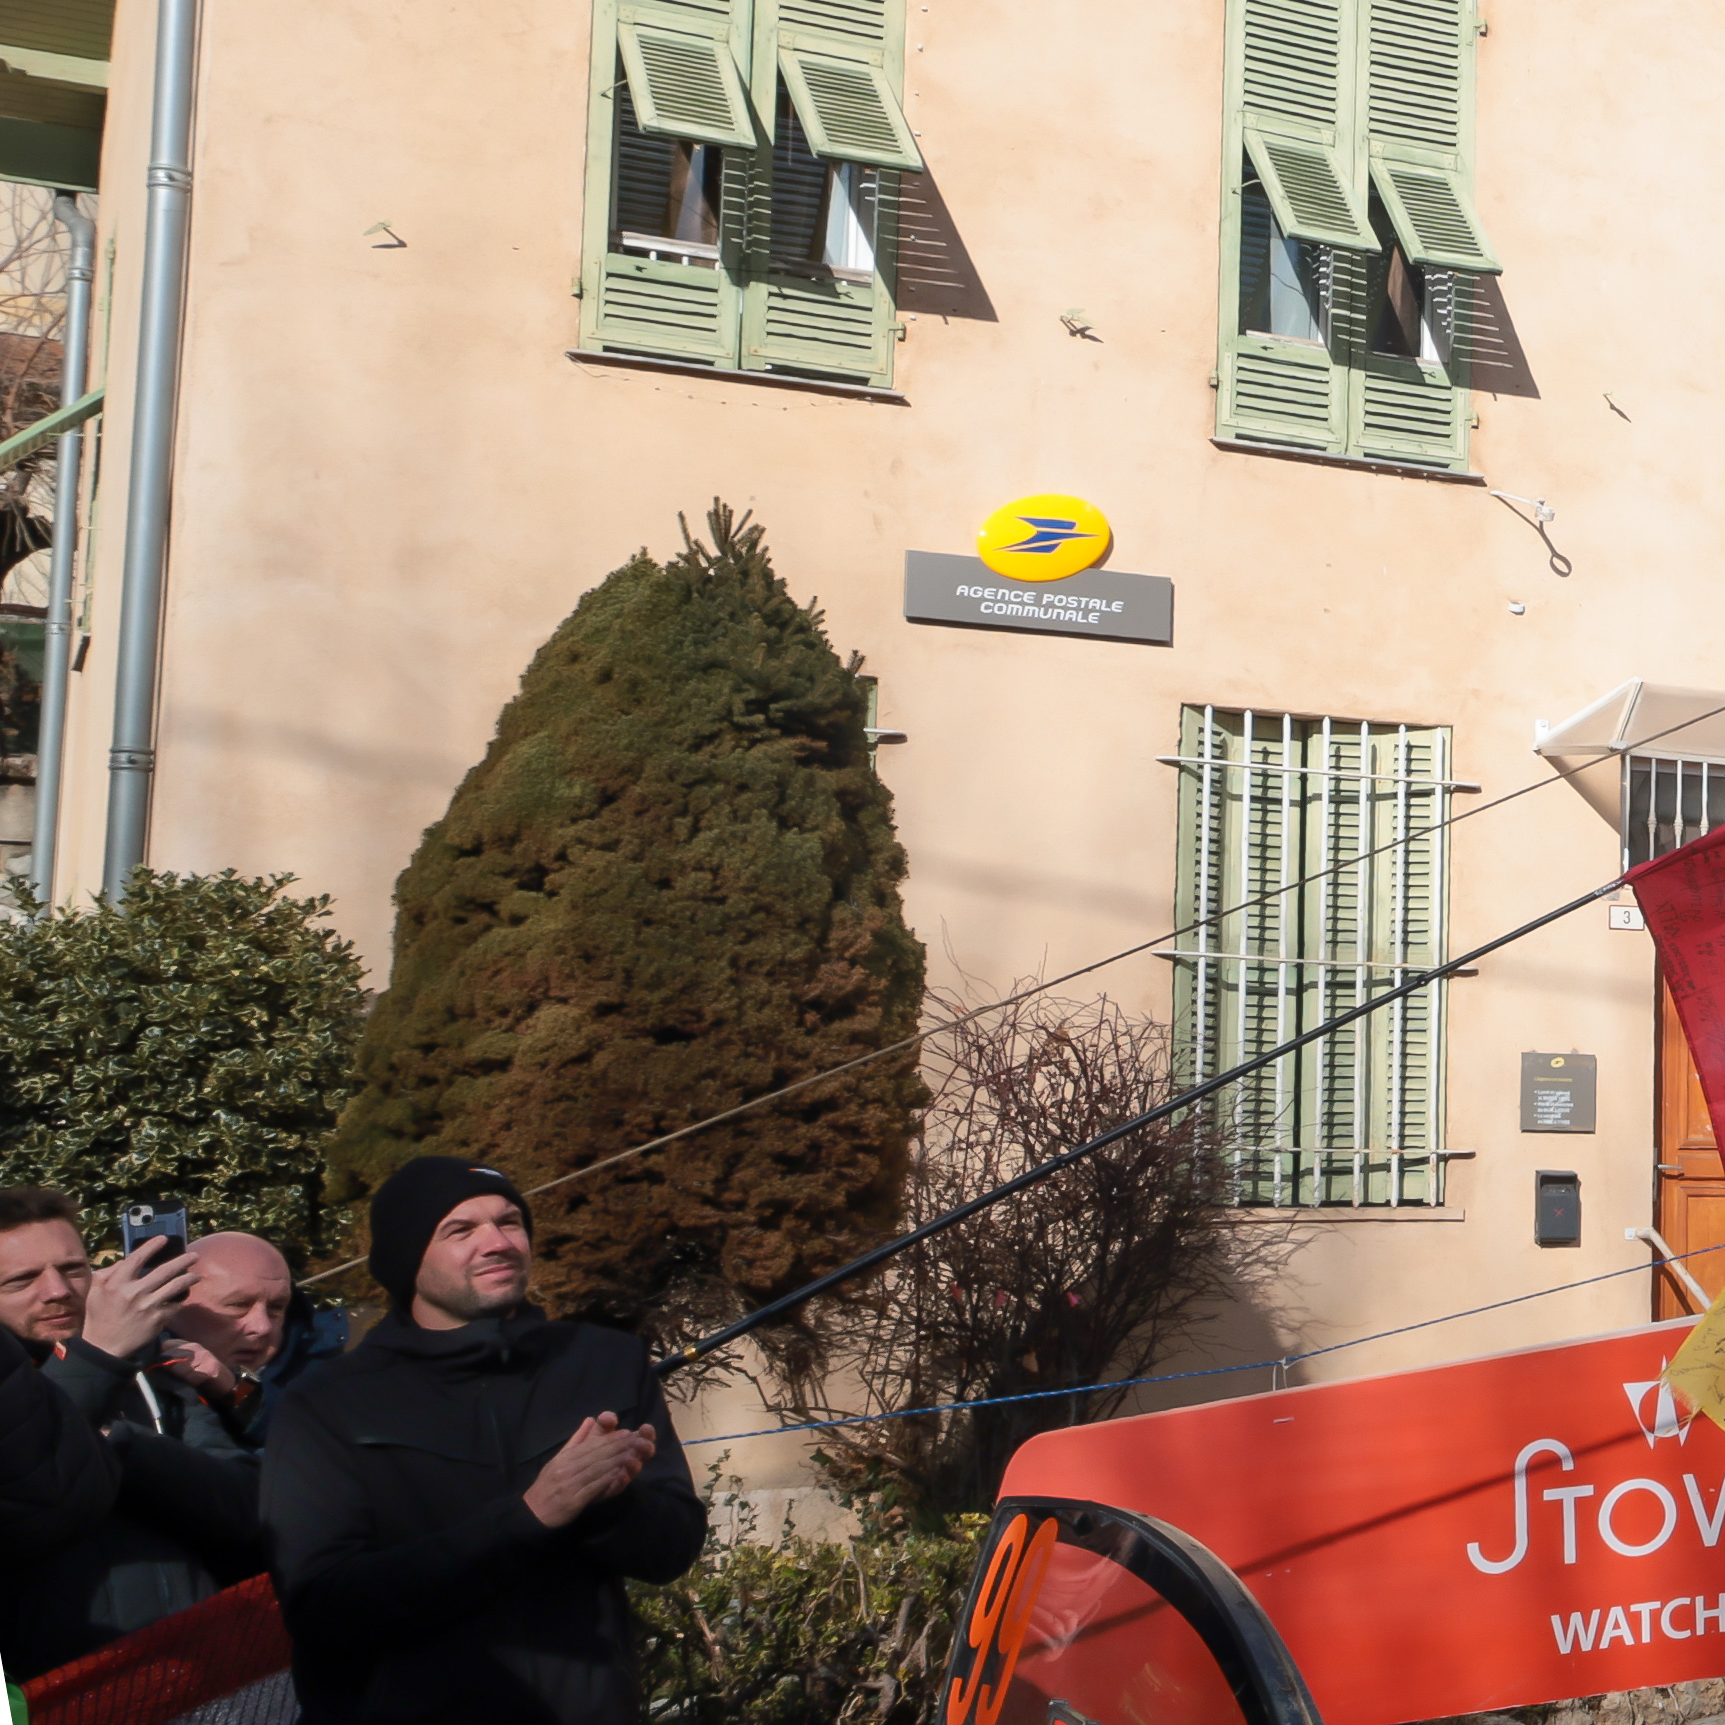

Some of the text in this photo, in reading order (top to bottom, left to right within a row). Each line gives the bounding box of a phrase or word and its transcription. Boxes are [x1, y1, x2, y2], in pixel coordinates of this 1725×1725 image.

[955, 584, 1125, 613] AGENCE POSTALE
[980, 602, 1100, 624] COMMUNALE
[1622, 909, 1632, 927] 3
